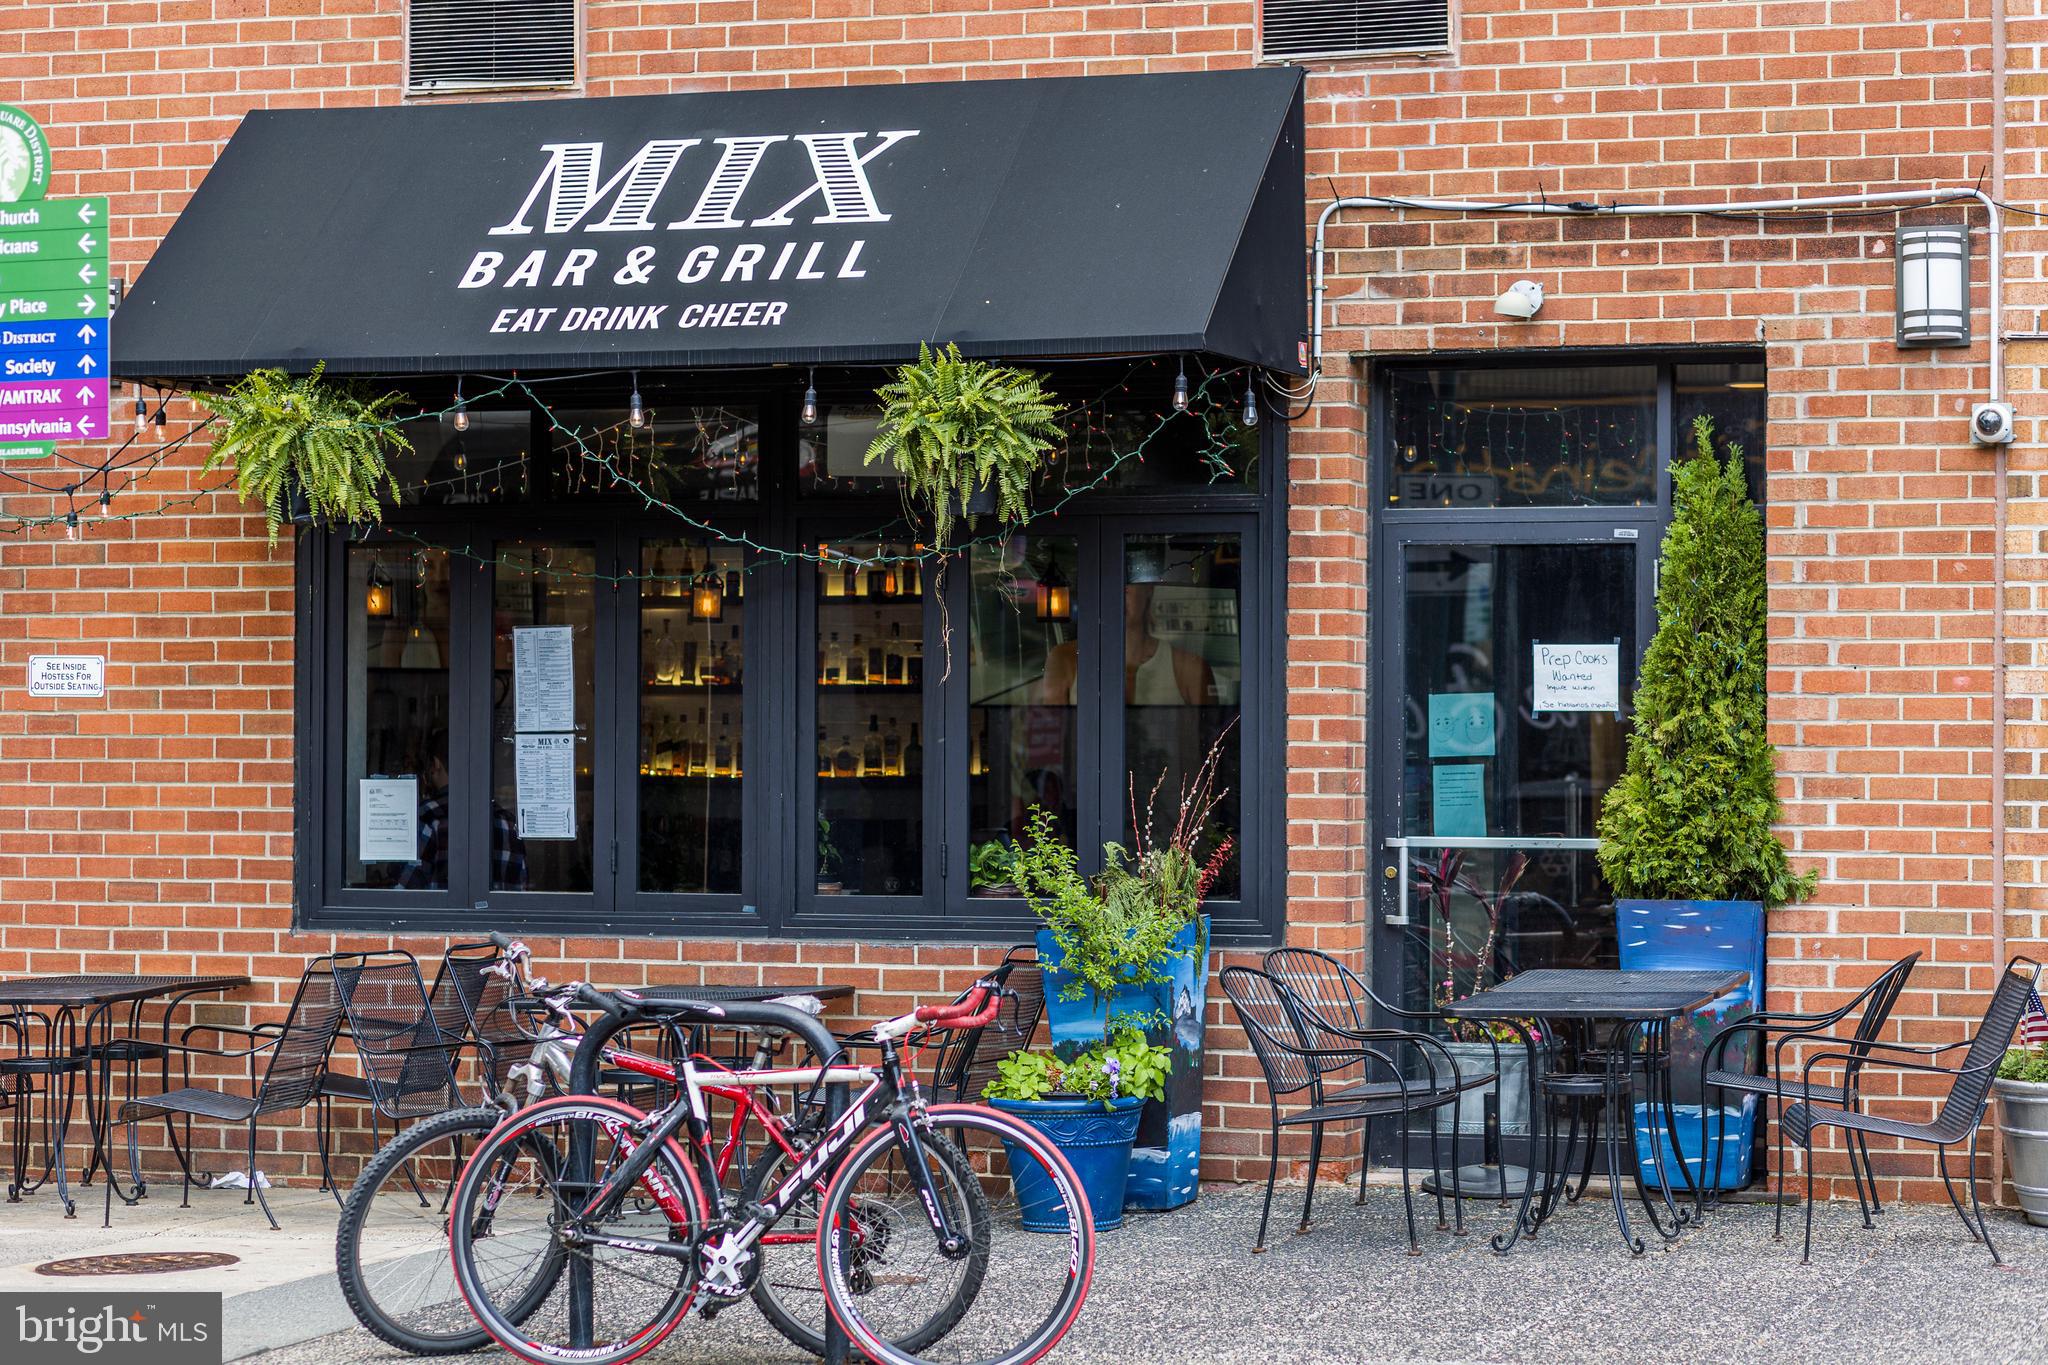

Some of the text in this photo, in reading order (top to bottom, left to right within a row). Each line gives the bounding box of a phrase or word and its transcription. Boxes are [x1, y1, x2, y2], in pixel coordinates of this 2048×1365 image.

[24, 124, 44, 185] DISTRICT
[487, 130, 920, 236] MIX
[457, 240, 868, 289] BAR & GRILL
[9, 298, 48, 314] Place
[489, 301, 789, 333] EAT DRINK CHEER
[2, 330, 57, 345] DISTRICT
[5, 358, 56, 377] Society
[46, 661, 87, 671] SEE INSIDE
[1541, 647, 1608, 669] Prep Cooks
[41, 672, 92, 681] HOSTESS FOR
[1552, 670, 1593, 681] Wanted
[33, 681, 99, 691] OUTSIDE SEATING
[537, 738, 552, 746] MIX
[778, 1103, 866, 1208] FUJI
[920, 1188, 942, 1228] FUJI
[607, 1239, 656, 1251] FUJI
[698, 1280, 747, 1297] FUJI
[558, 1344, 616, 1359] WEINMANN
